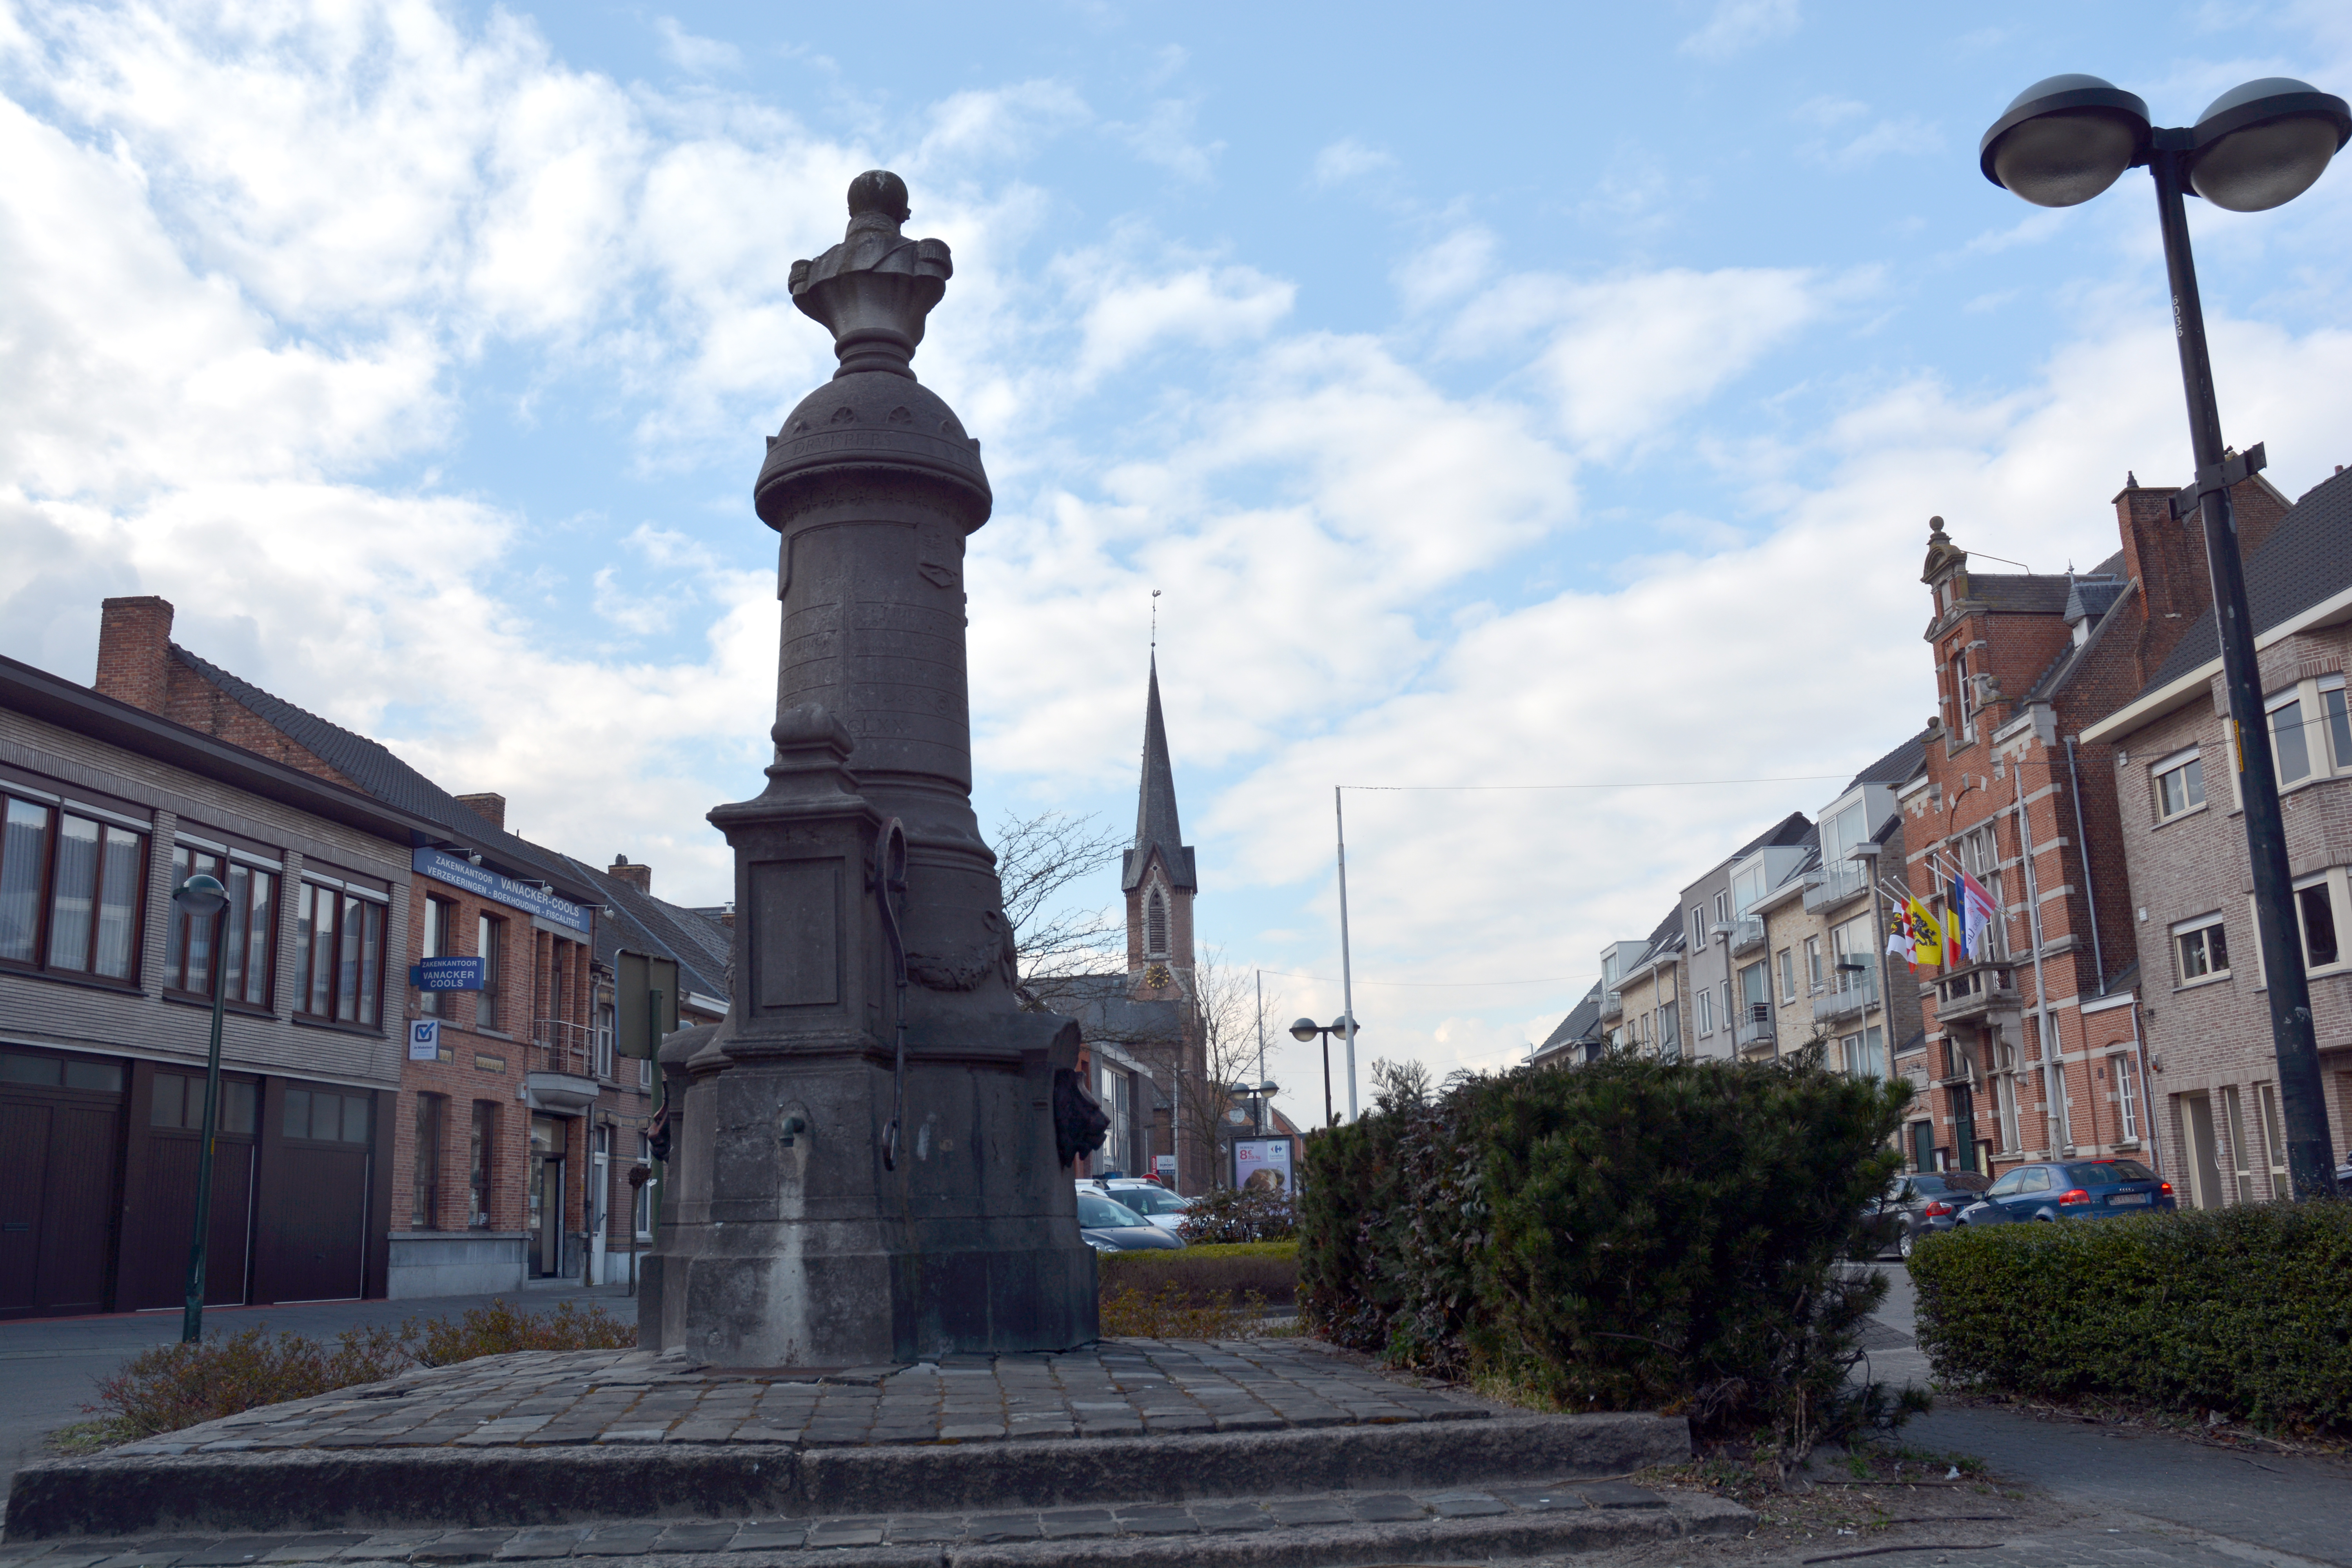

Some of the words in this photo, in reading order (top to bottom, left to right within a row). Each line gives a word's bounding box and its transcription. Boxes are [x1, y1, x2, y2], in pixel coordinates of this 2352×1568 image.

[2172, 295, 2183, 337] 6036
[428, 865, 486, 894] VERZEKERINGEN
[493, 890, 540, 913] BOEKHOUDING
[546, 909, 580, 928] FISCALITEIT
[436, 856, 493, 884] ZAKENKANTOOR
[501, 878, 579, 917] VANACKER-COOLS
[423, 971, 474, 979] VANACKER
[430, 979, 463, 987] COOLS
[1240, 1150, 1247, 1160] 8
